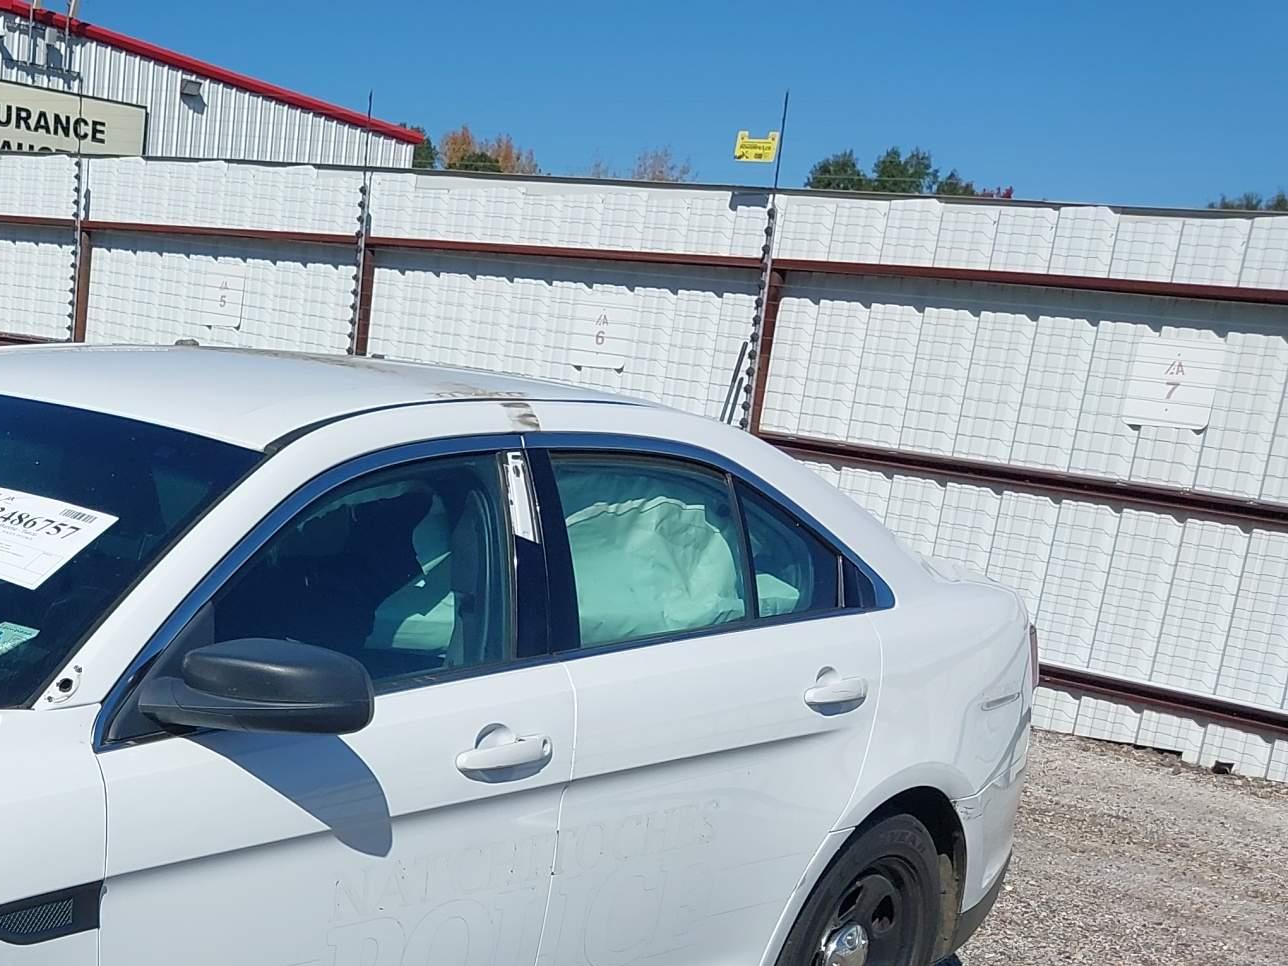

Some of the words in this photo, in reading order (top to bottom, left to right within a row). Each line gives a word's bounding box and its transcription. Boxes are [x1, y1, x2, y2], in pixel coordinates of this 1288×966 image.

[218, 294, 228, 308] 5
[595, 329, 607, 346] 6
[1165, 382, 1181, 399] 7
